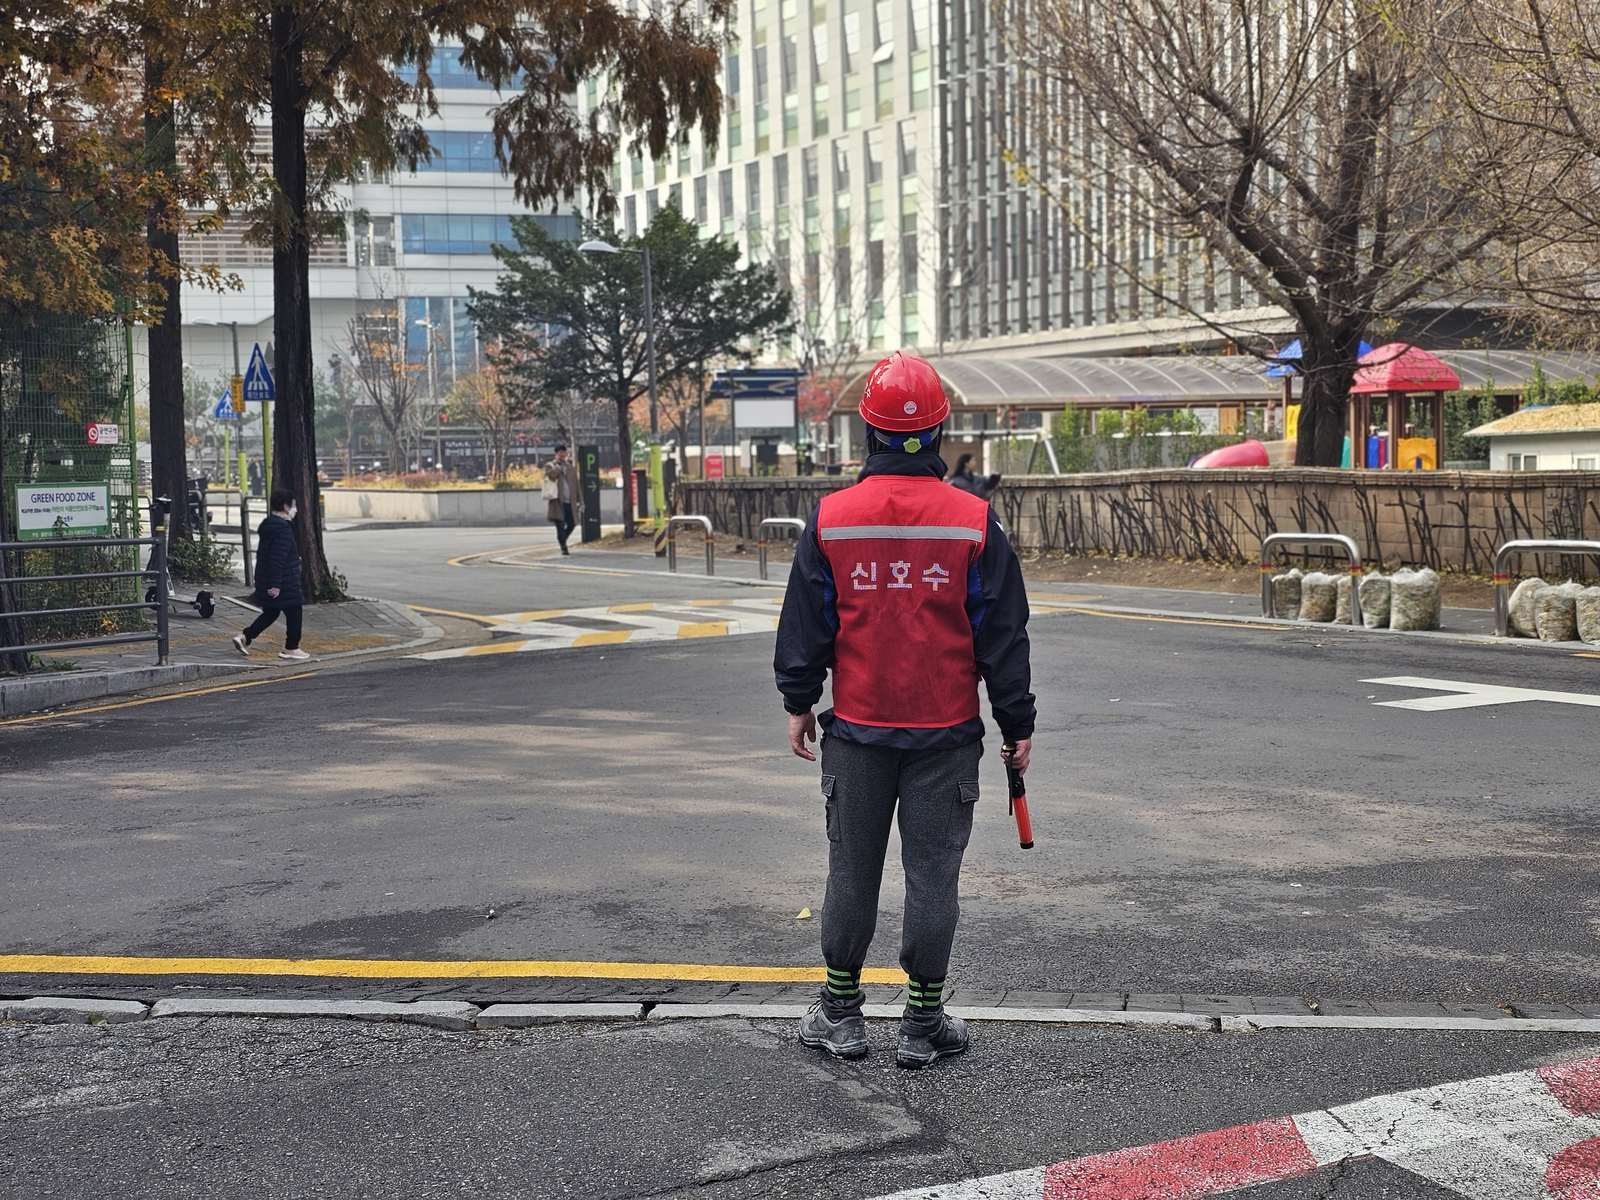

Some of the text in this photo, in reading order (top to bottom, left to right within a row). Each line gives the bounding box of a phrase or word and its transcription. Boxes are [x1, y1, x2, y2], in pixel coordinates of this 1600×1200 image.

[587, 454, 596, 470] P
[31, 492, 96, 503] GREEN FOOD ZONE
[850, 560, 950, 591] 신호수
